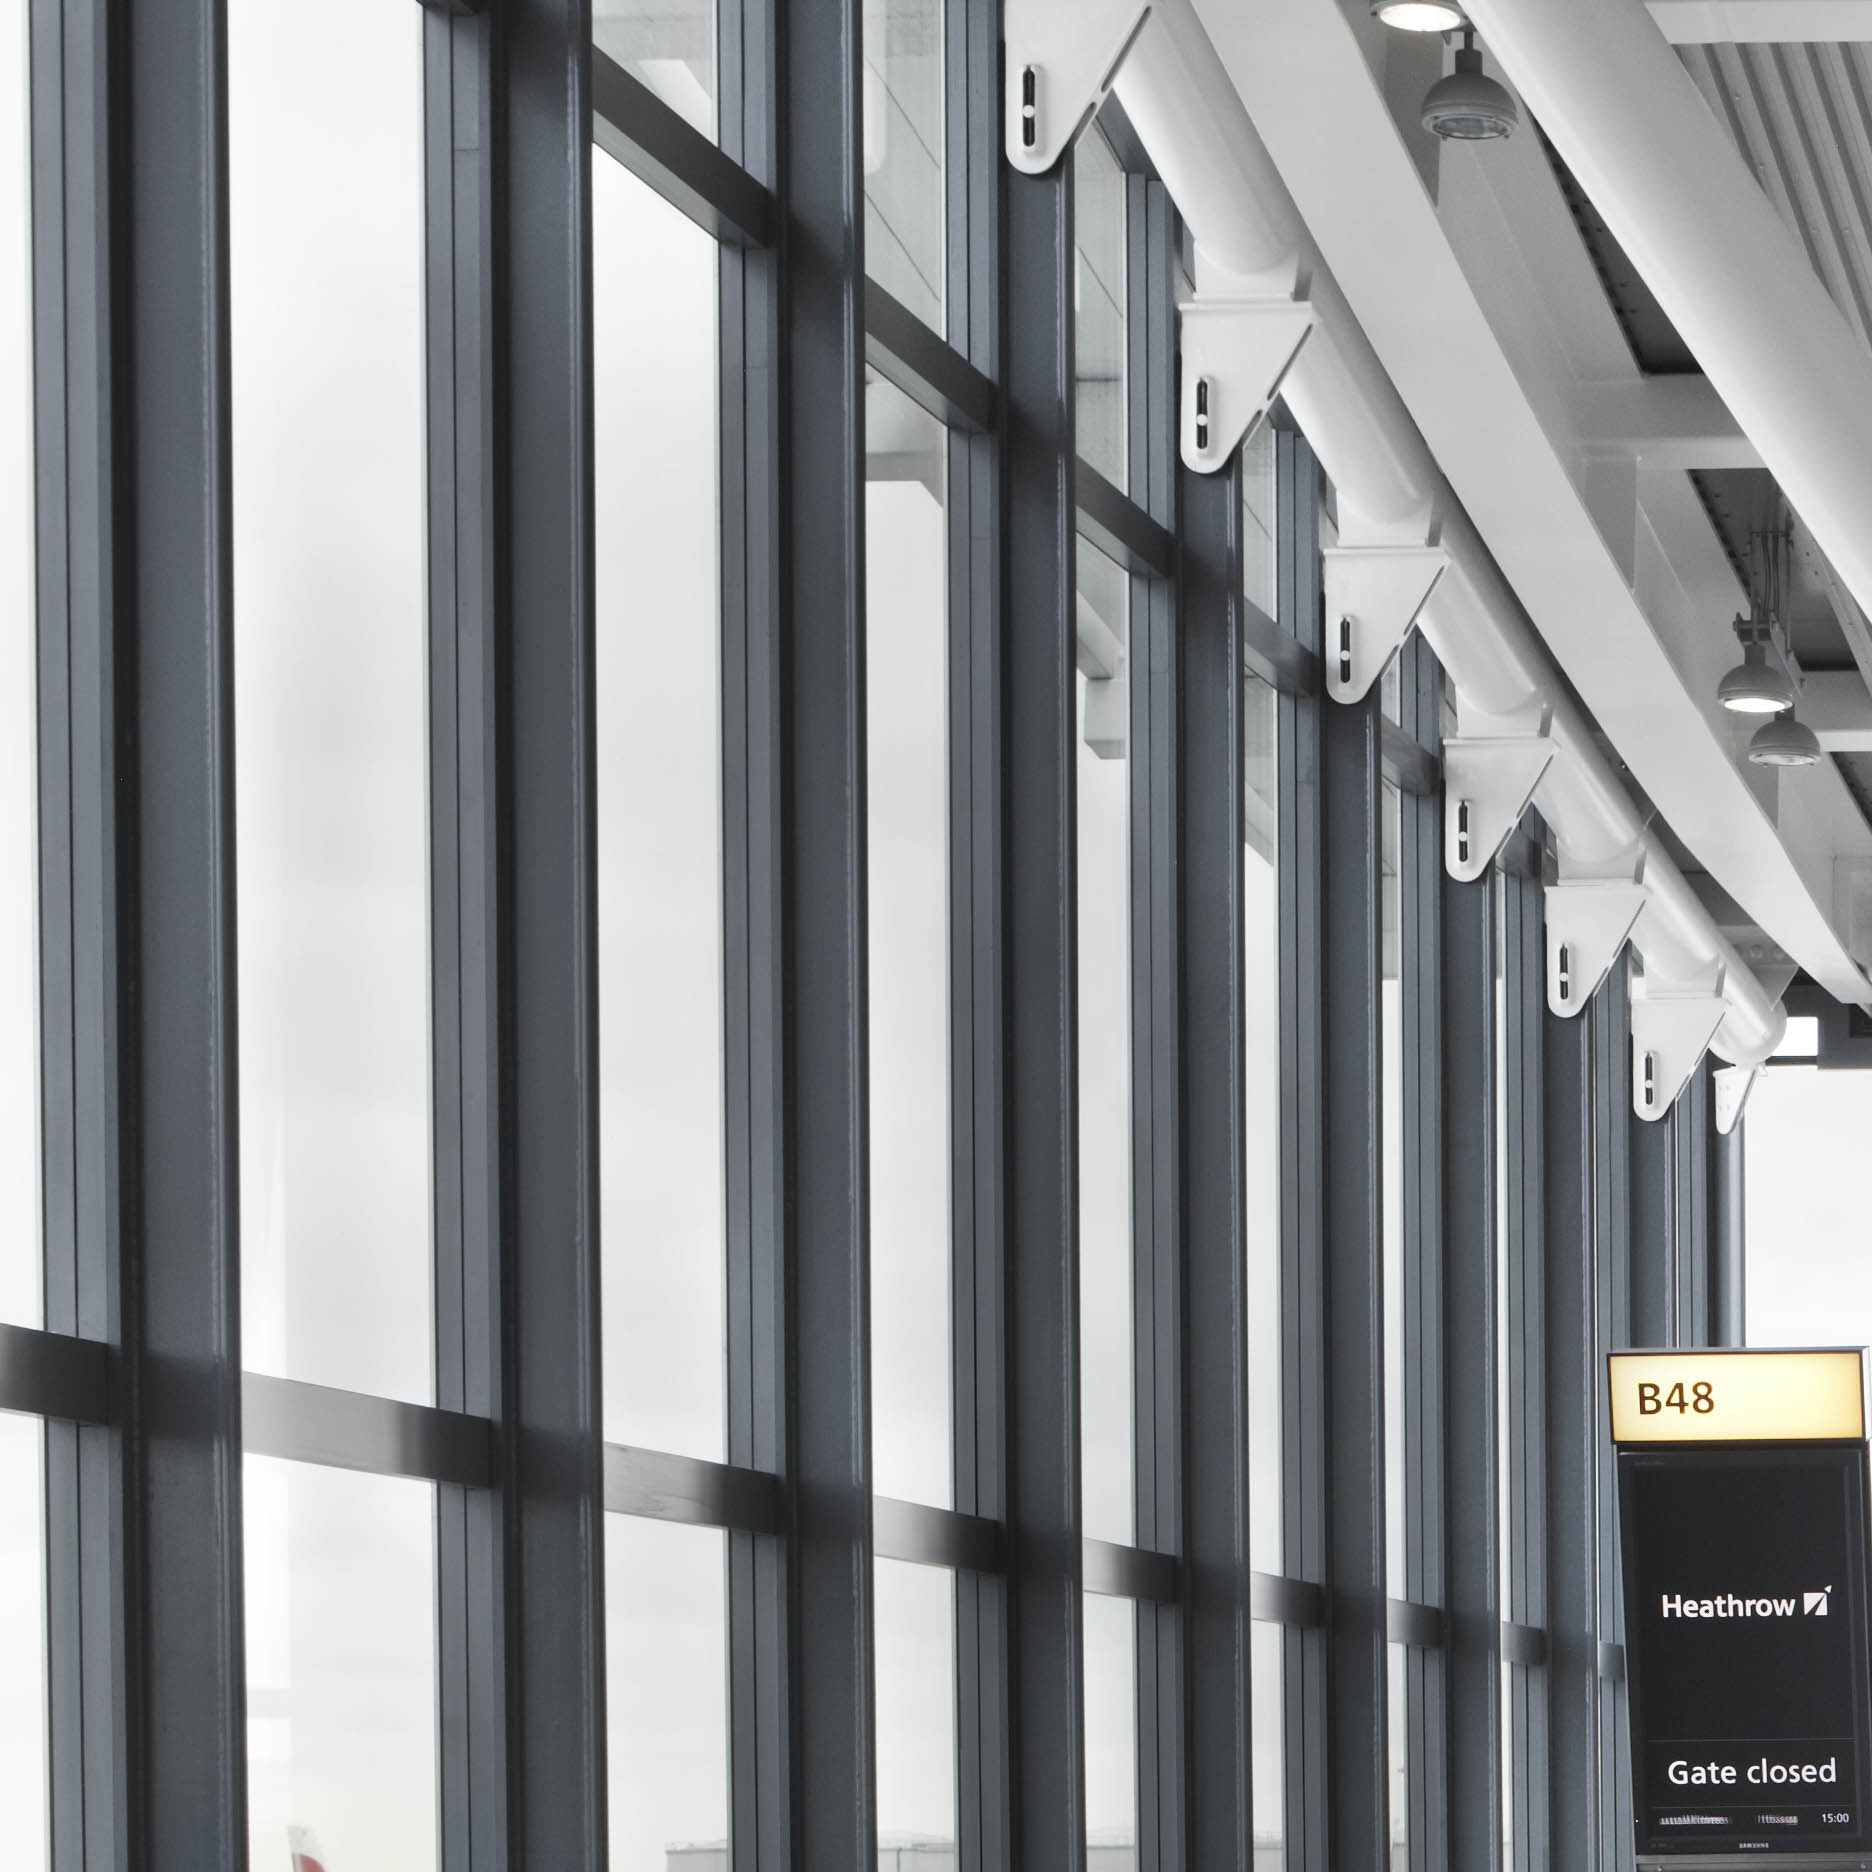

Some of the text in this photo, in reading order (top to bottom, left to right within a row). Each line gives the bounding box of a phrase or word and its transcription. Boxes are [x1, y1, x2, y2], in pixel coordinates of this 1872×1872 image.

[1638, 1381, 1715, 1415] B48
[1662, 1593, 1796, 1619] Heathrow
[1668, 1756, 1837, 1786] Gate closed
[1822, 1813, 1850, 1824] 15:00
